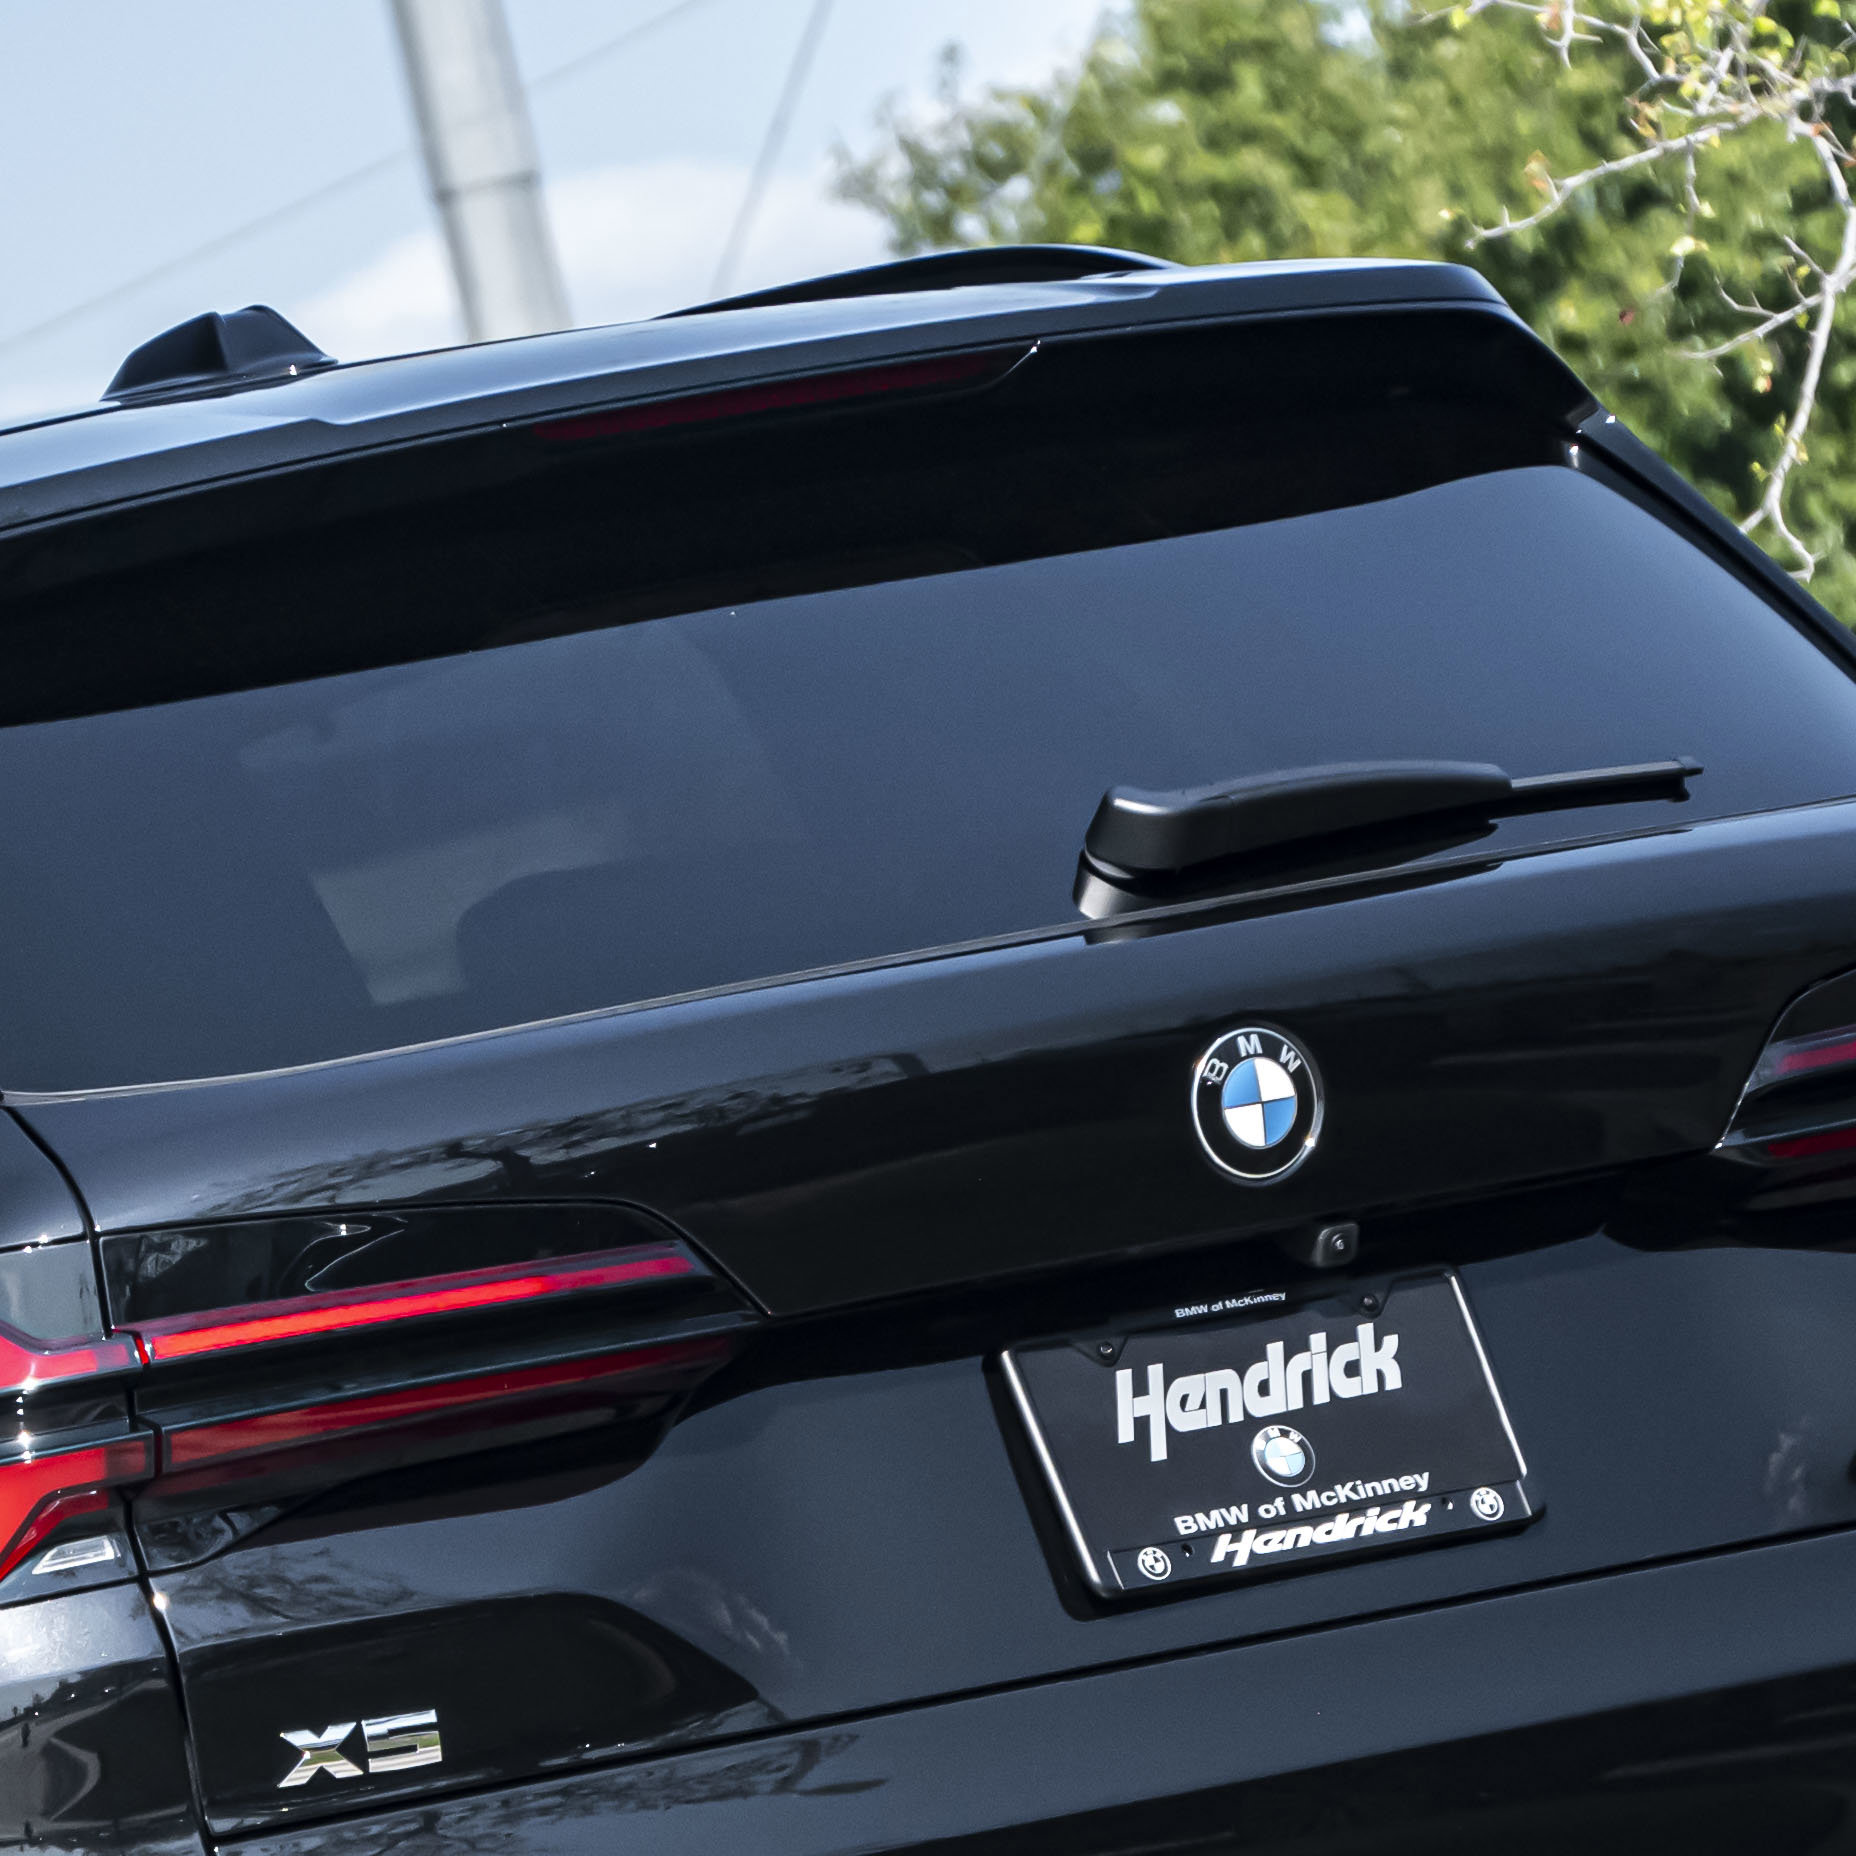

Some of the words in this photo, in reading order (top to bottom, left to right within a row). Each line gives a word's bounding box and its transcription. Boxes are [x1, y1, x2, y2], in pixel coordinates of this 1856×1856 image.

[1202, 1033, 1302, 1085] BMW
[1173, 1303, 1209, 1319] BMW
[1210, 1300, 1225, 1313] of
[1224, 1290, 1287, 1309] McKinney
[1114, 1321, 1403, 1463] Hendrick
[1173, 1503, 1250, 1536] BMW
[1256, 1496, 1286, 1521] of
[1291, 1471, 1431, 1513] McKinney
[1209, 1499, 1432, 1567] Hendrick
[276, 1708, 444, 1789] X5
